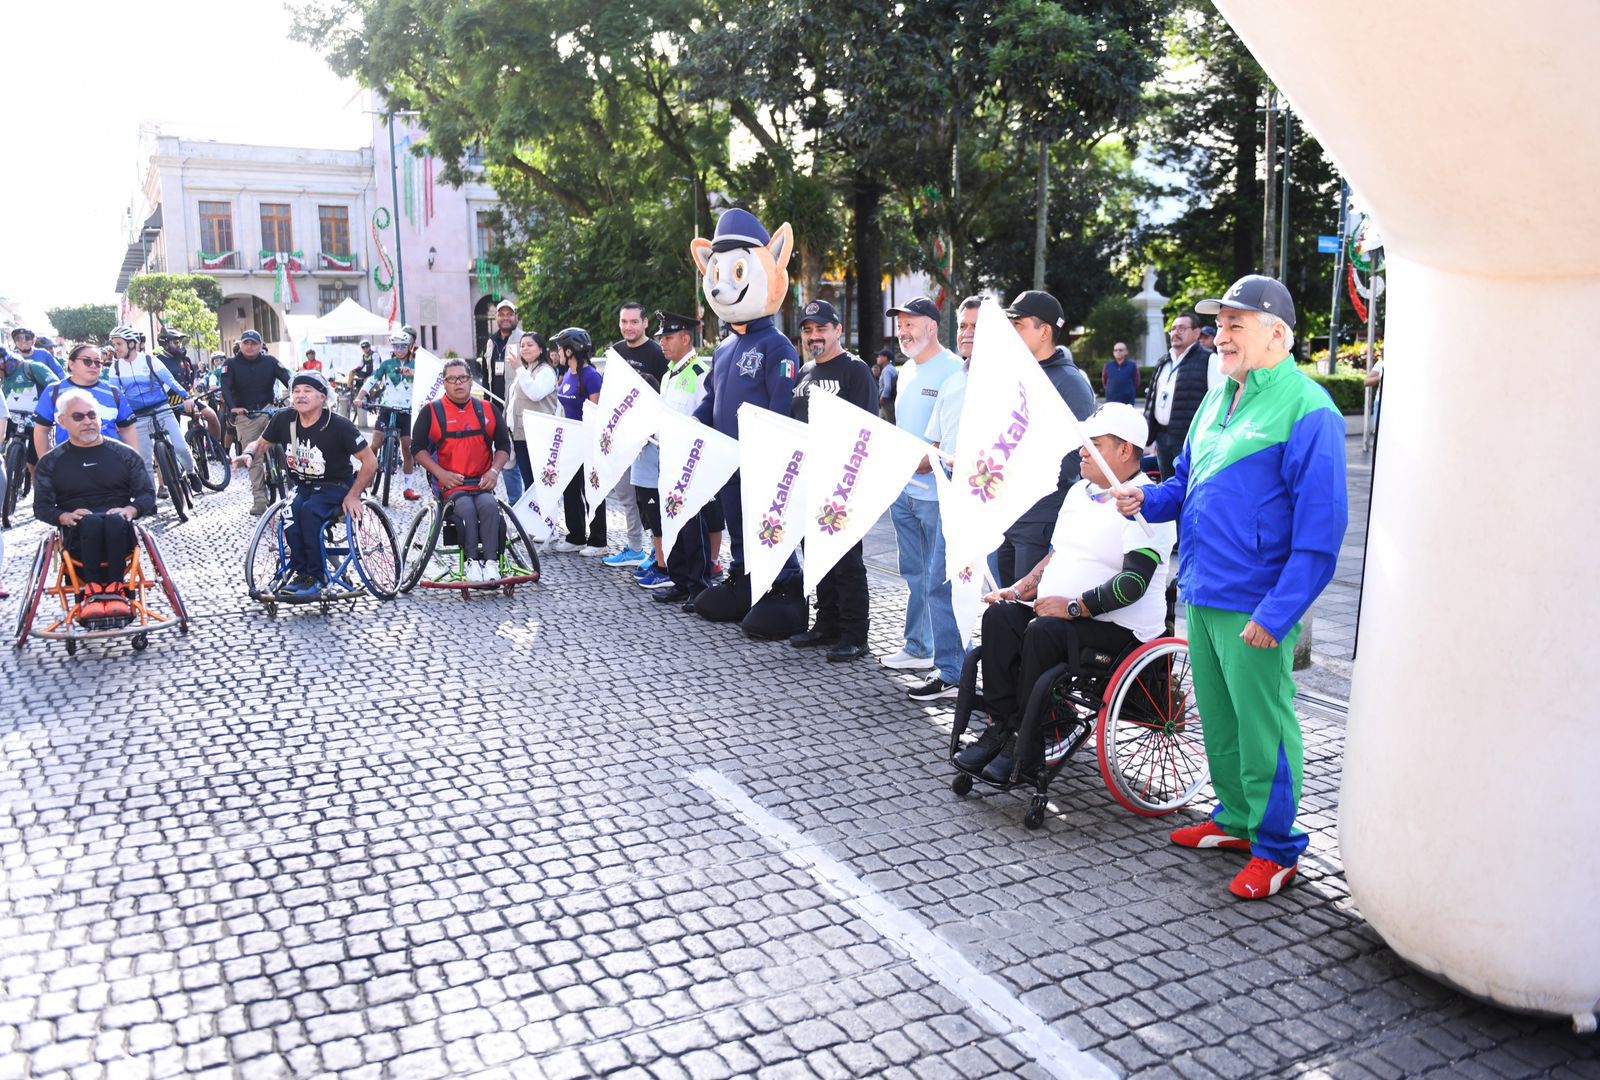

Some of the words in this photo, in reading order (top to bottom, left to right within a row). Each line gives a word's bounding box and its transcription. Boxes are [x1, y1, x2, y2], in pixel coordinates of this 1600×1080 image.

[607, 387, 640, 434] Xalapa
[992, 380, 1029, 462] Xal
[546, 427, 564, 468] Xalapa
[674, 438, 705, 494] Xalapa
[832, 428, 872, 502] Xalapa
[769, 450, 804, 517] Xalapa
[528, 500, 555, 529] Xapa
